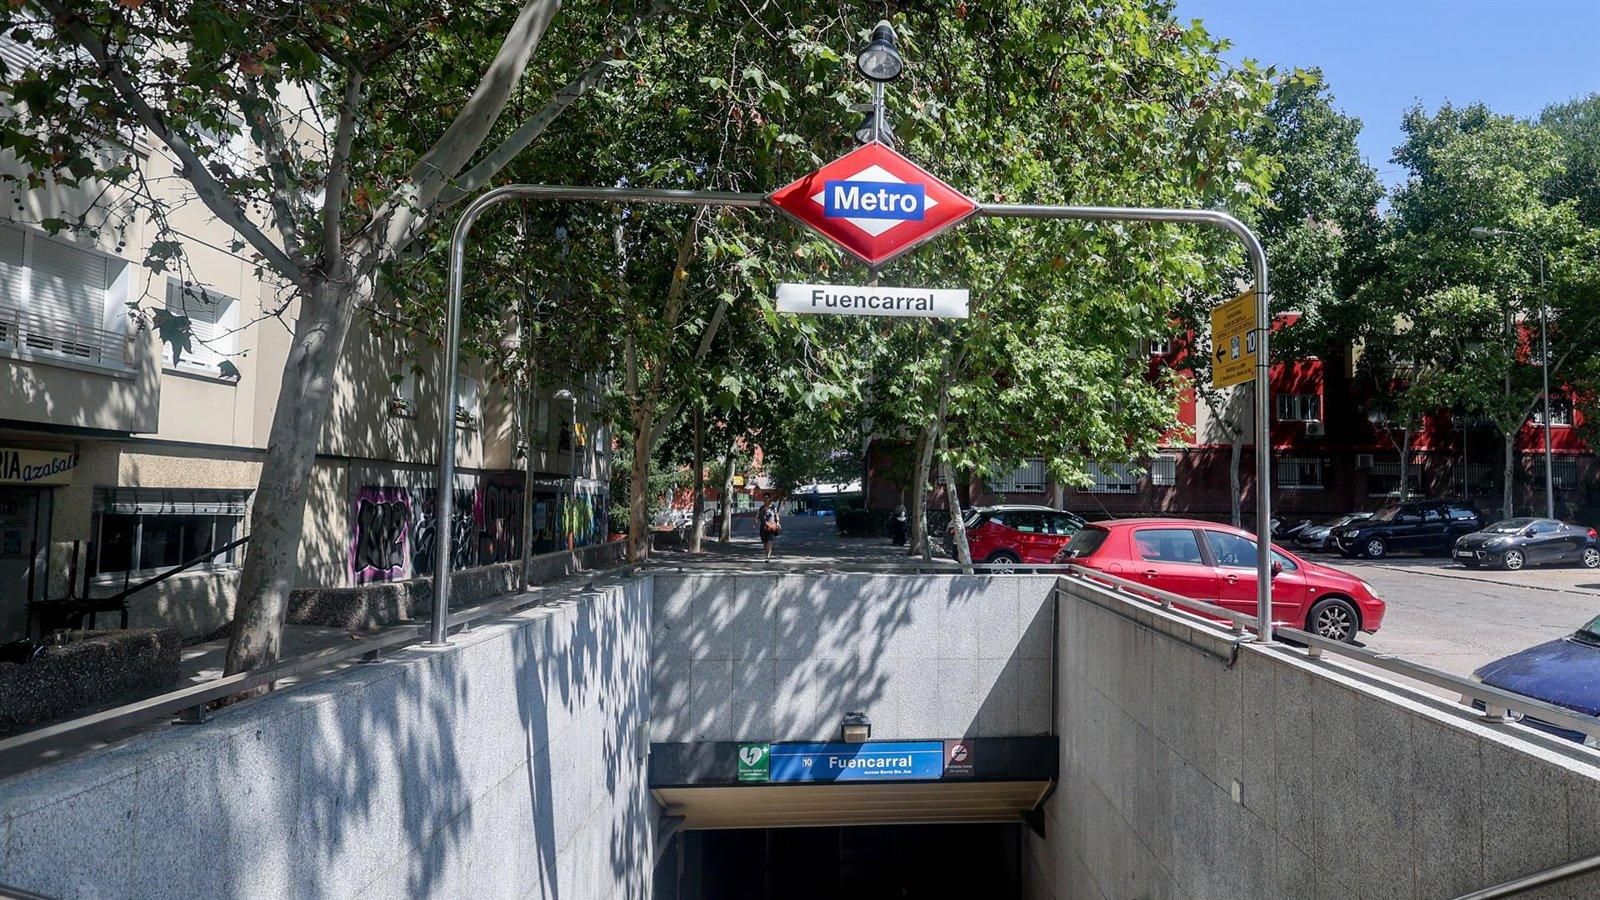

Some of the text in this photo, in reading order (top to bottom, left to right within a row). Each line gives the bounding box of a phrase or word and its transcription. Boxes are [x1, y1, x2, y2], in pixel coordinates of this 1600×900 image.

[834, 186, 917, 212] Metro
[811, 289, 934, 311] Fuencarral
[1246, 332, 1255, 352] 10
[0, 450, 20, 479] IA
[803, 758, 813, 766] 10
[829, 755, 912, 769] Fuencarral
